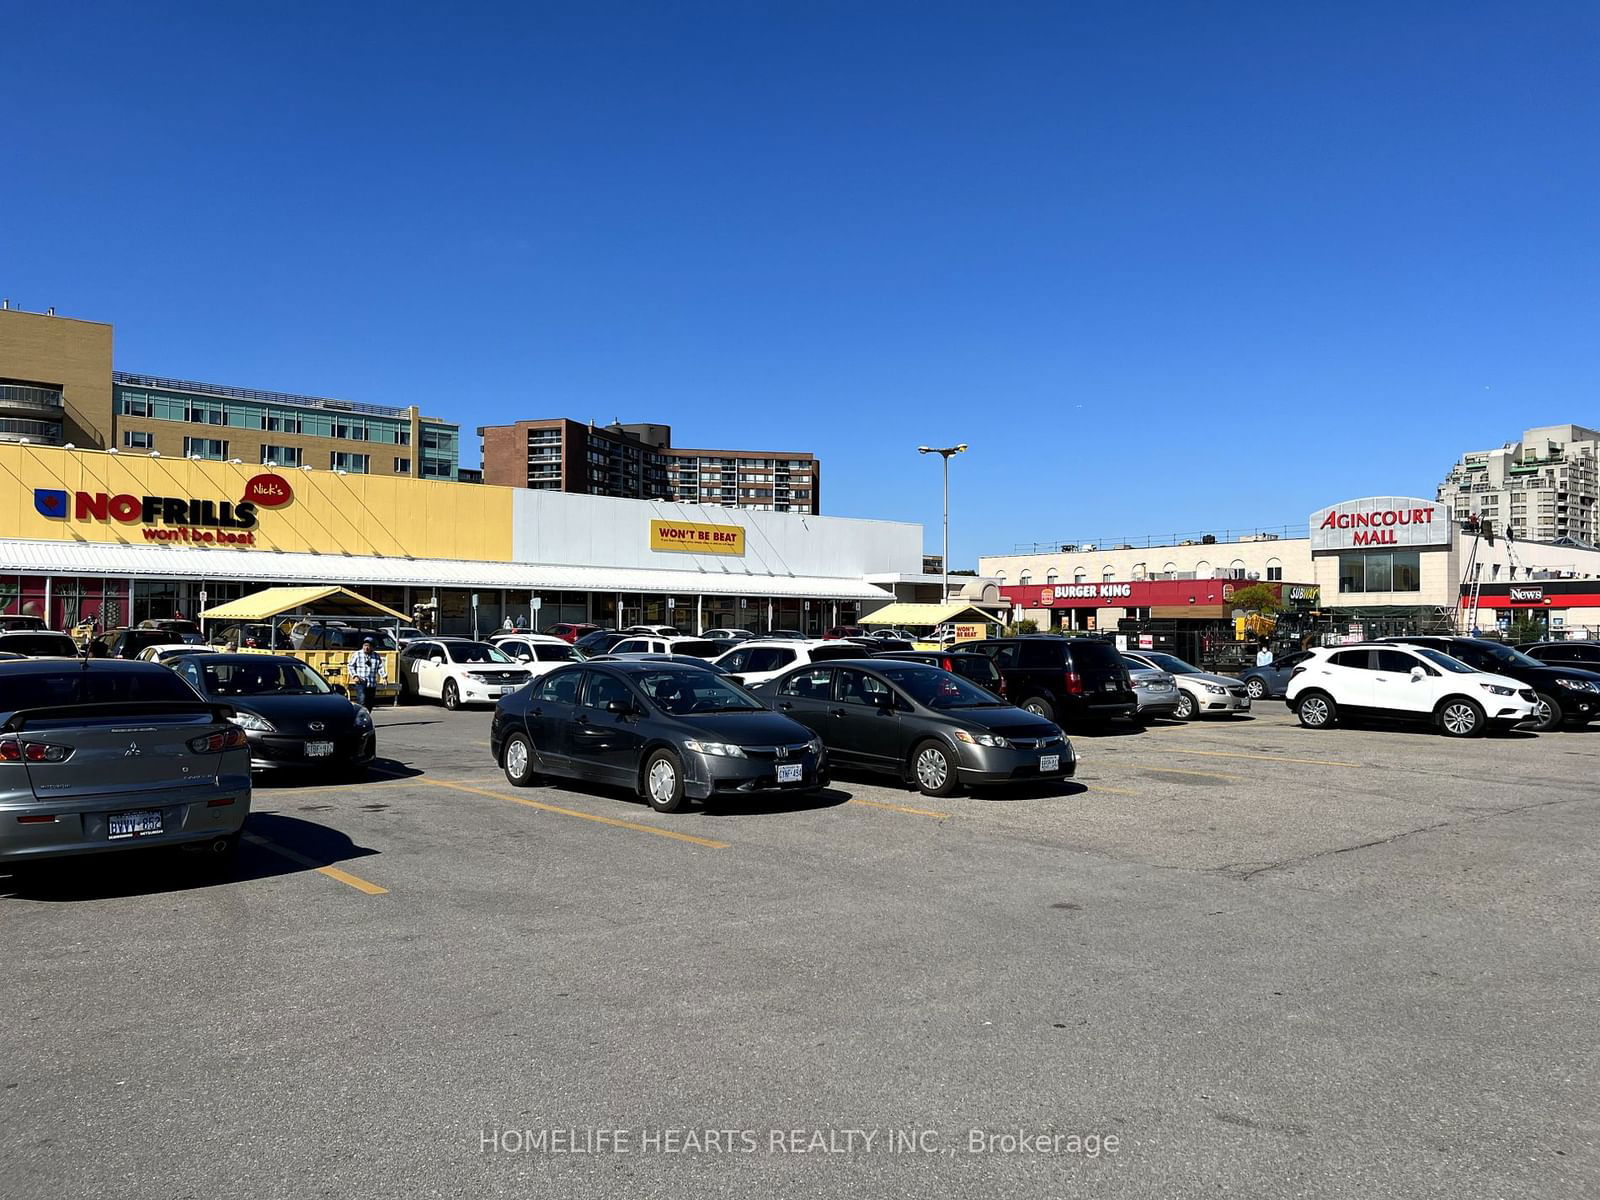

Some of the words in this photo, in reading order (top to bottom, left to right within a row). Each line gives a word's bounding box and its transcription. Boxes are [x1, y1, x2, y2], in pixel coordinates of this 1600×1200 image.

[253, 484, 284, 497] Nick's
[1319, 508, 1435, 530] AGINCOURT
[142, 527, 189, 542] won't
[191, 529, 214, 543] be
[216, 530, 255, 545] beat
[659, 528, 695, 540] WON'T
[698, 531, 710, 541] BE
[713, 532, 737, 542] BEAT
[1352, 529, 1398, 546] MALL
[1055, 586, 1097, 599] BURGER
[1100, 584, 1131, 598] KING
[1290, 586, 1318, 600] SUBWAY
